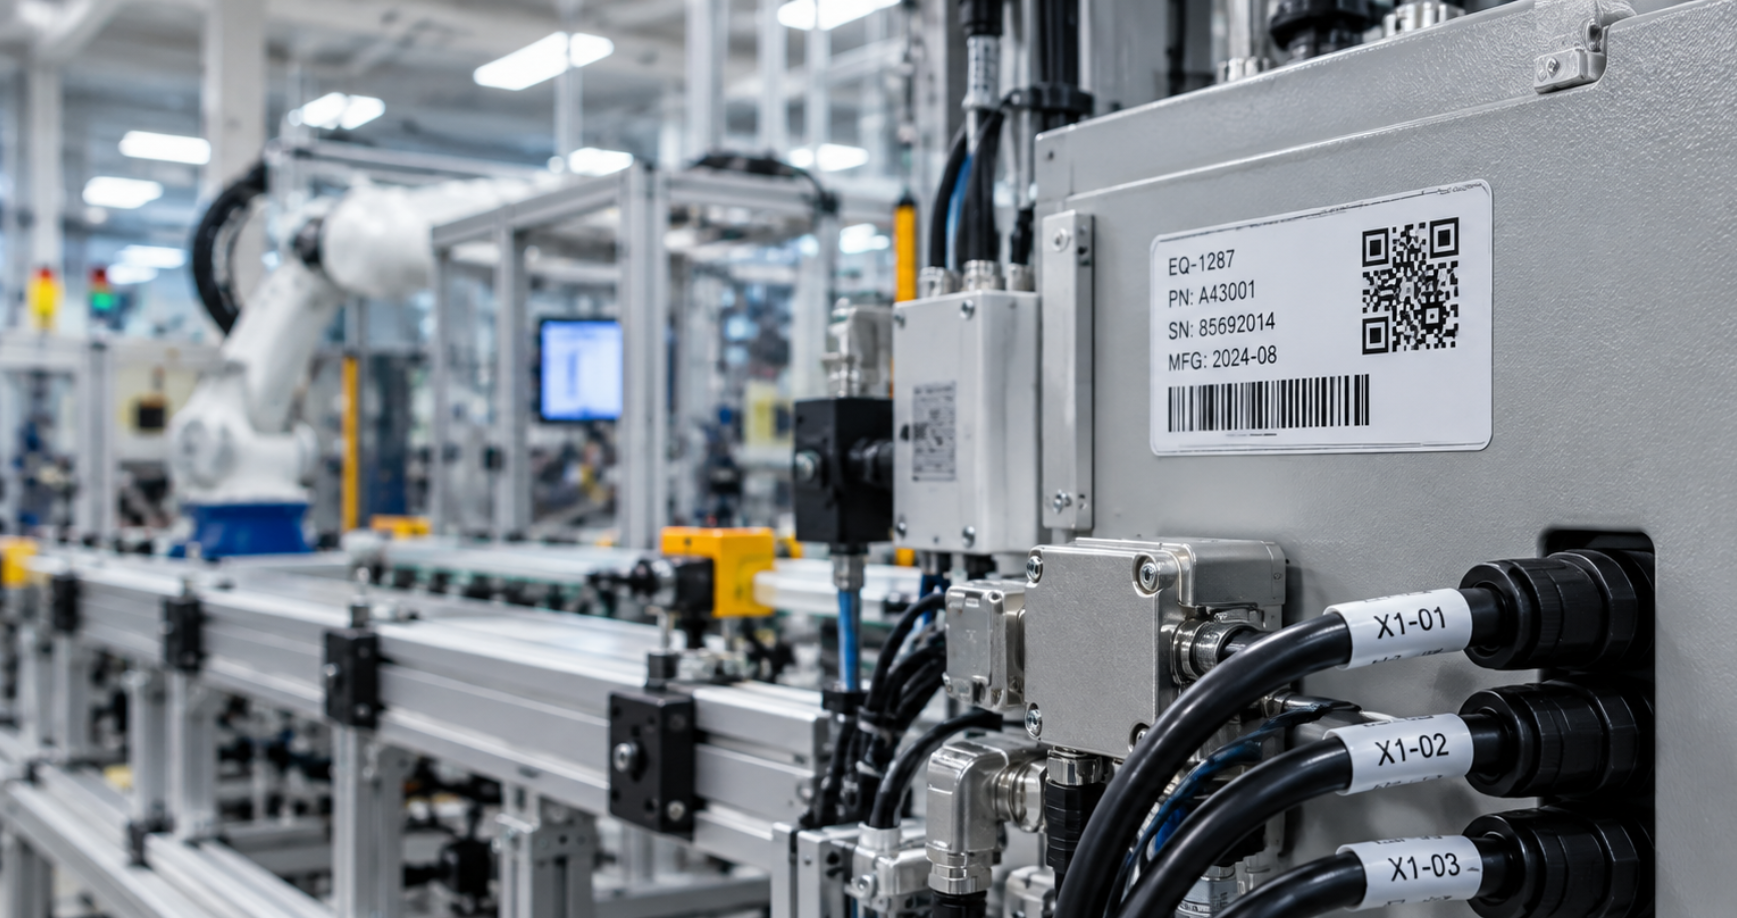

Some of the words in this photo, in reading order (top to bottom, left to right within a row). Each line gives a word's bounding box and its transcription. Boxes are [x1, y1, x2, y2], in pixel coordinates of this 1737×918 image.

[1168, 249, 1236, 276] EQ-1287
[1168, 288, 1194, 308] PN:
[1198, 279, 1256, 305] A43001
[1168, 320, 1194, 341] SN:
[1198, 311, 1276, 338] 85692014
[1168, 351, 1208, 371] MFG:
[1212, 344, 1278, 369] 2024-08
[1373, 606, 1447, 640] X1-01
[1374, 732, 1450, 767] X1-02
[1387, 852, 1461, 882] X1-03
